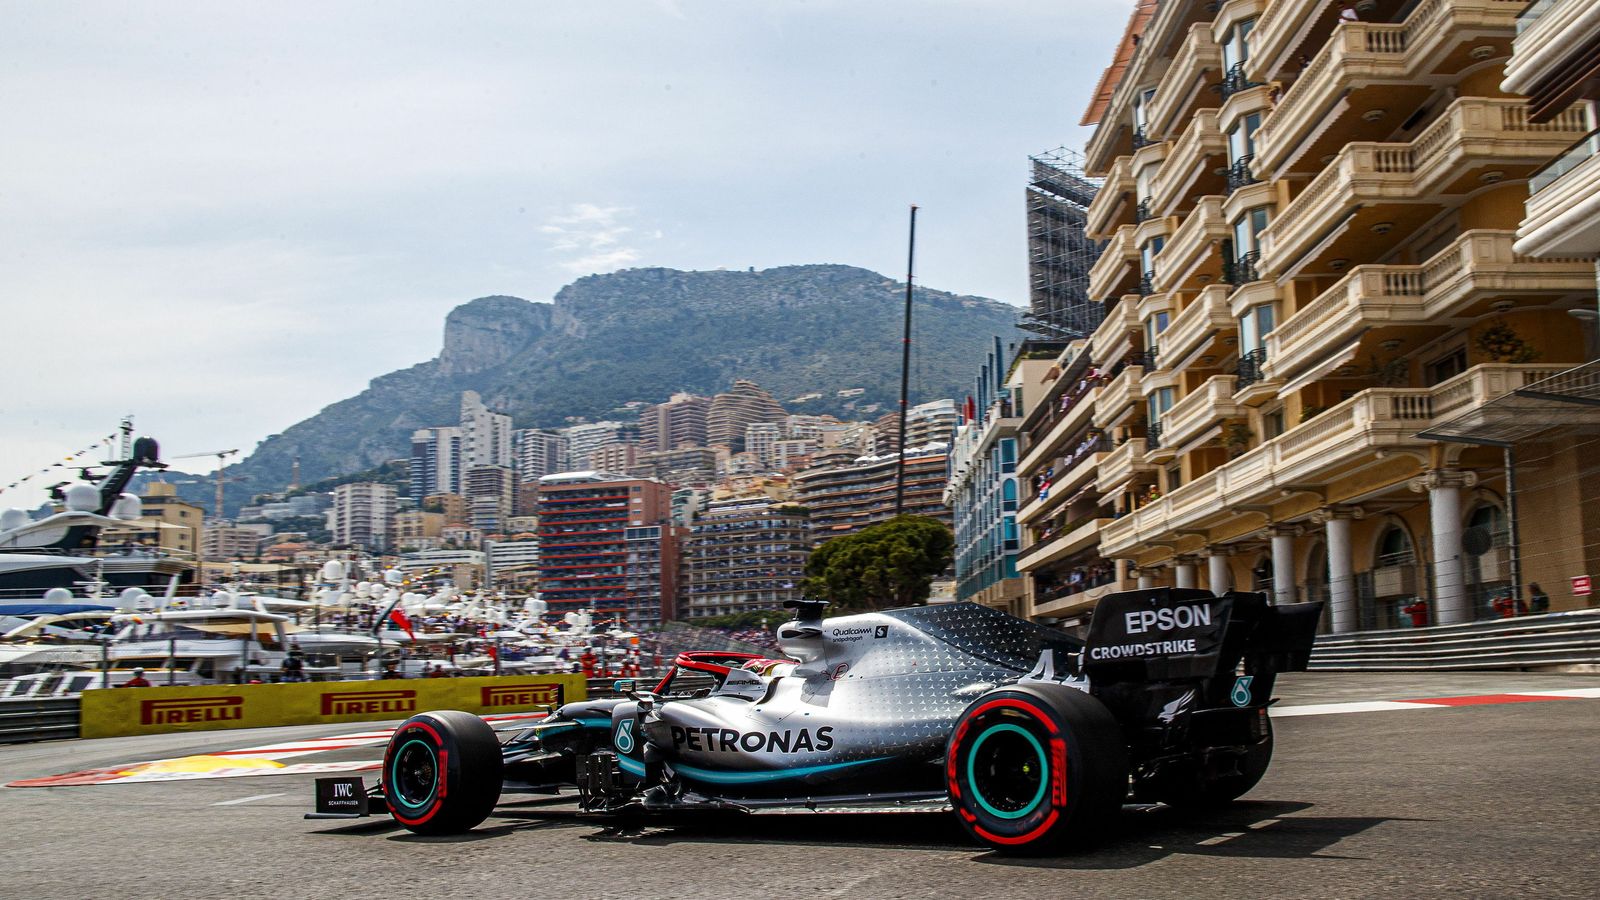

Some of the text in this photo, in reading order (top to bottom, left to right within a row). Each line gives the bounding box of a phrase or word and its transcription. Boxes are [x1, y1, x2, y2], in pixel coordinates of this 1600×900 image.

[832, 627, 872, 637] Qualcomm
[1125, 604, 1211, 634] EPSON
[1091, 639, 1197, 659] CROWDSTRIKE
[140, 696, 244, 725] PIRELLI
[320, 689, 416, 716] PIRELLI
[670, 726, 834, 754] PETRONAS
[334, 784, 353, 797] IWC
